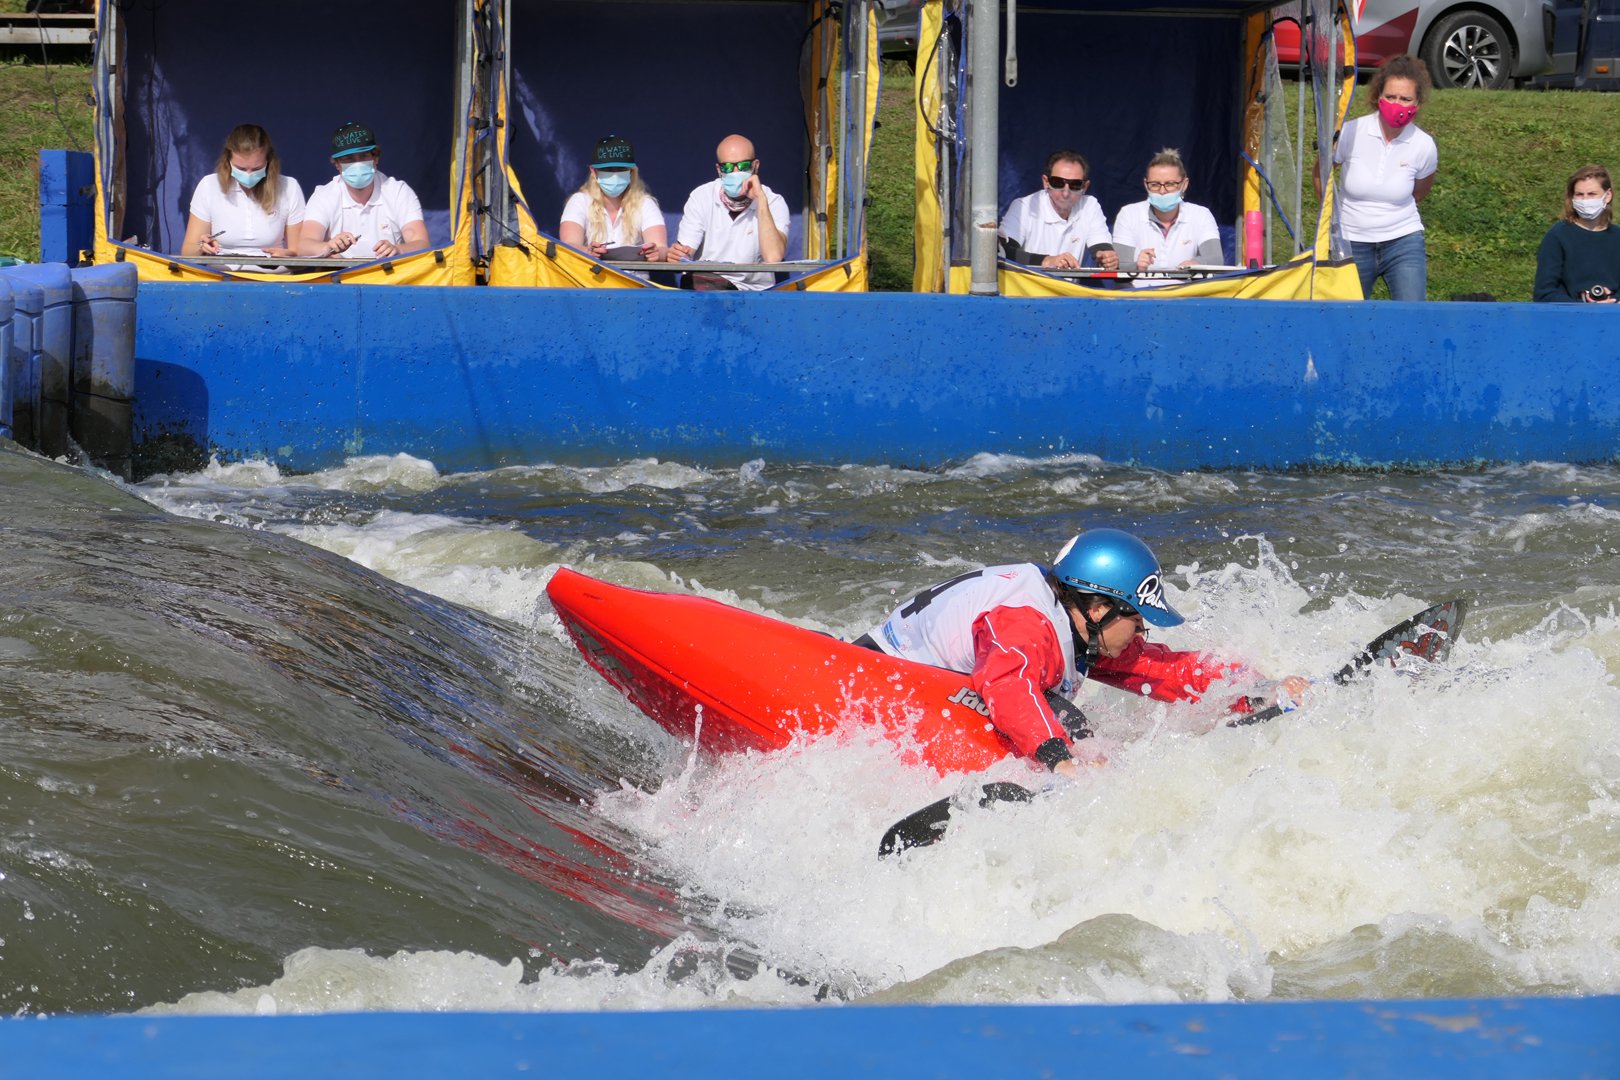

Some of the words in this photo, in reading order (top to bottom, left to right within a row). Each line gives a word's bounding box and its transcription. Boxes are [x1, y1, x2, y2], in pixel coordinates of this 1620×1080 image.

[342, 130, 368, 140] WATER
[347, 136, 361, 145] LIVE
[606, 145, 630, 153] WATER
[1137, 574, 1169, 613] Palm
